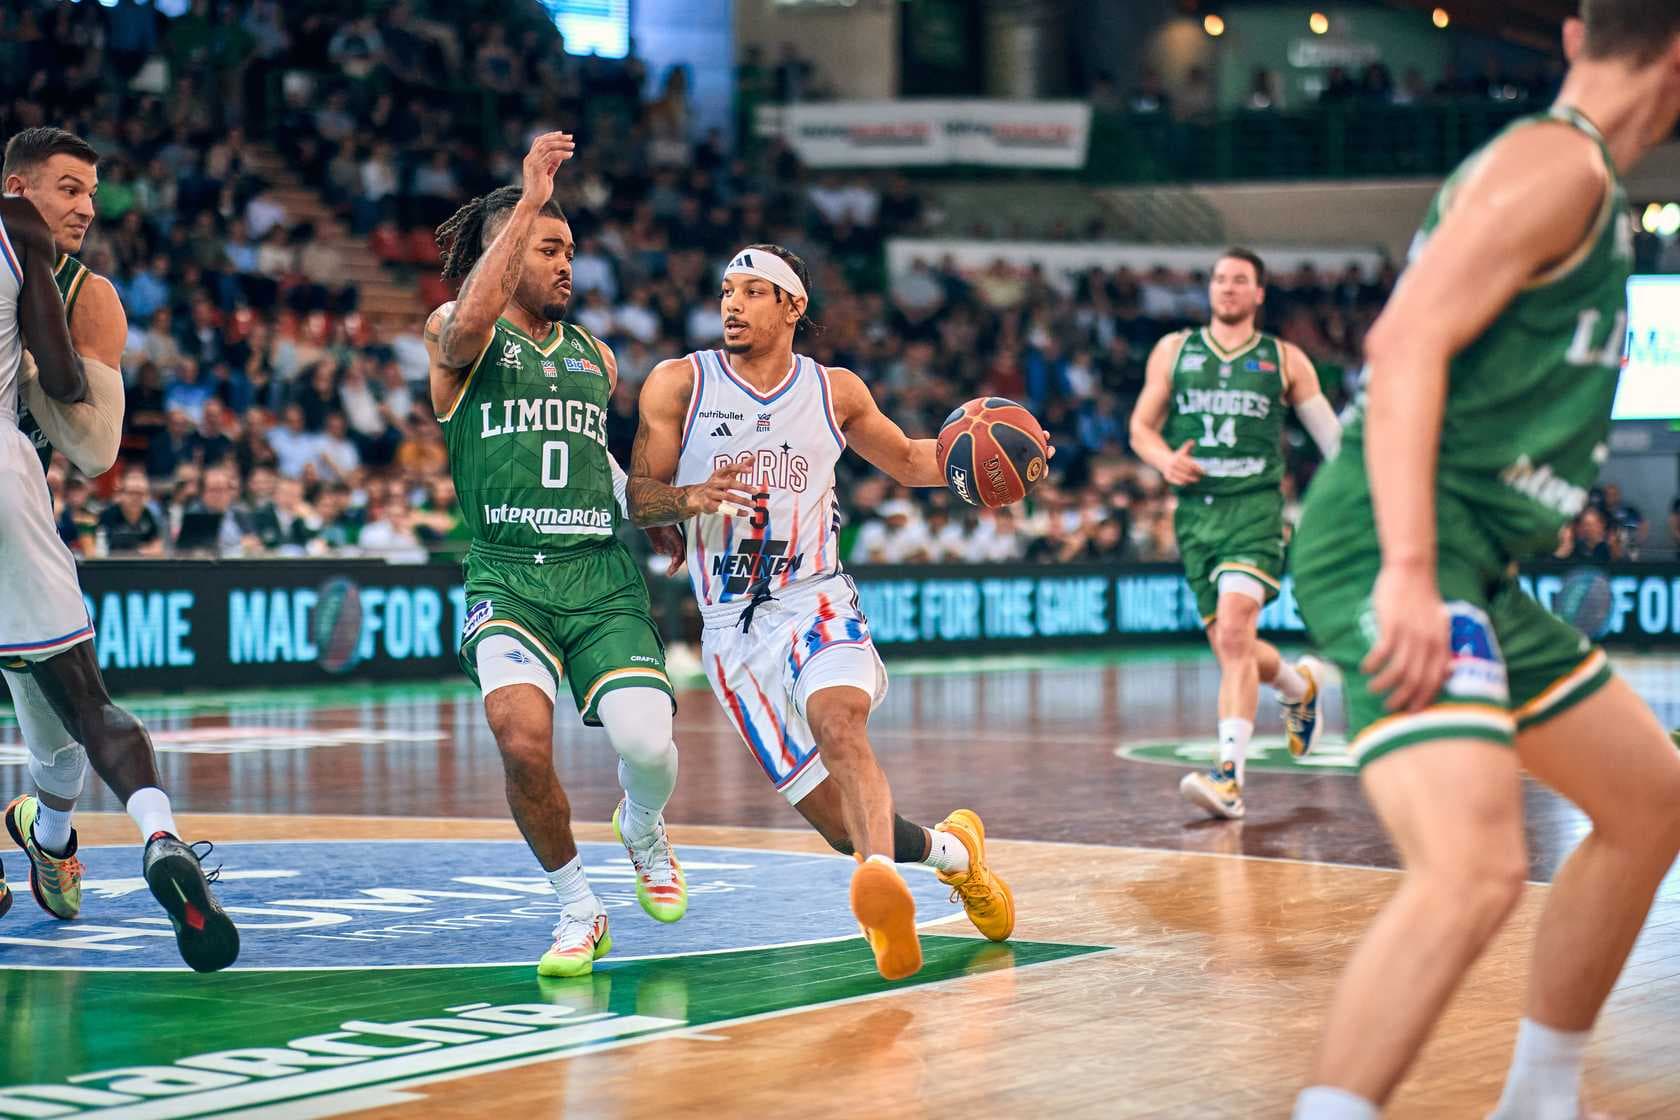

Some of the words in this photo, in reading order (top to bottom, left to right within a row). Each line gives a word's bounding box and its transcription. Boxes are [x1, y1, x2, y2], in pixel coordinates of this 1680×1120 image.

[480, 398, 608, 448] LIMOGES
[1198, 413, 1237, 448] 14
[541, 440, 569, 488] 0
[483, 503, 613, 536] Intermarché
[750, 493, 770, 529] 5
[83, 590, 195, 670] AME
[359, 587, 443, 660] FOR
